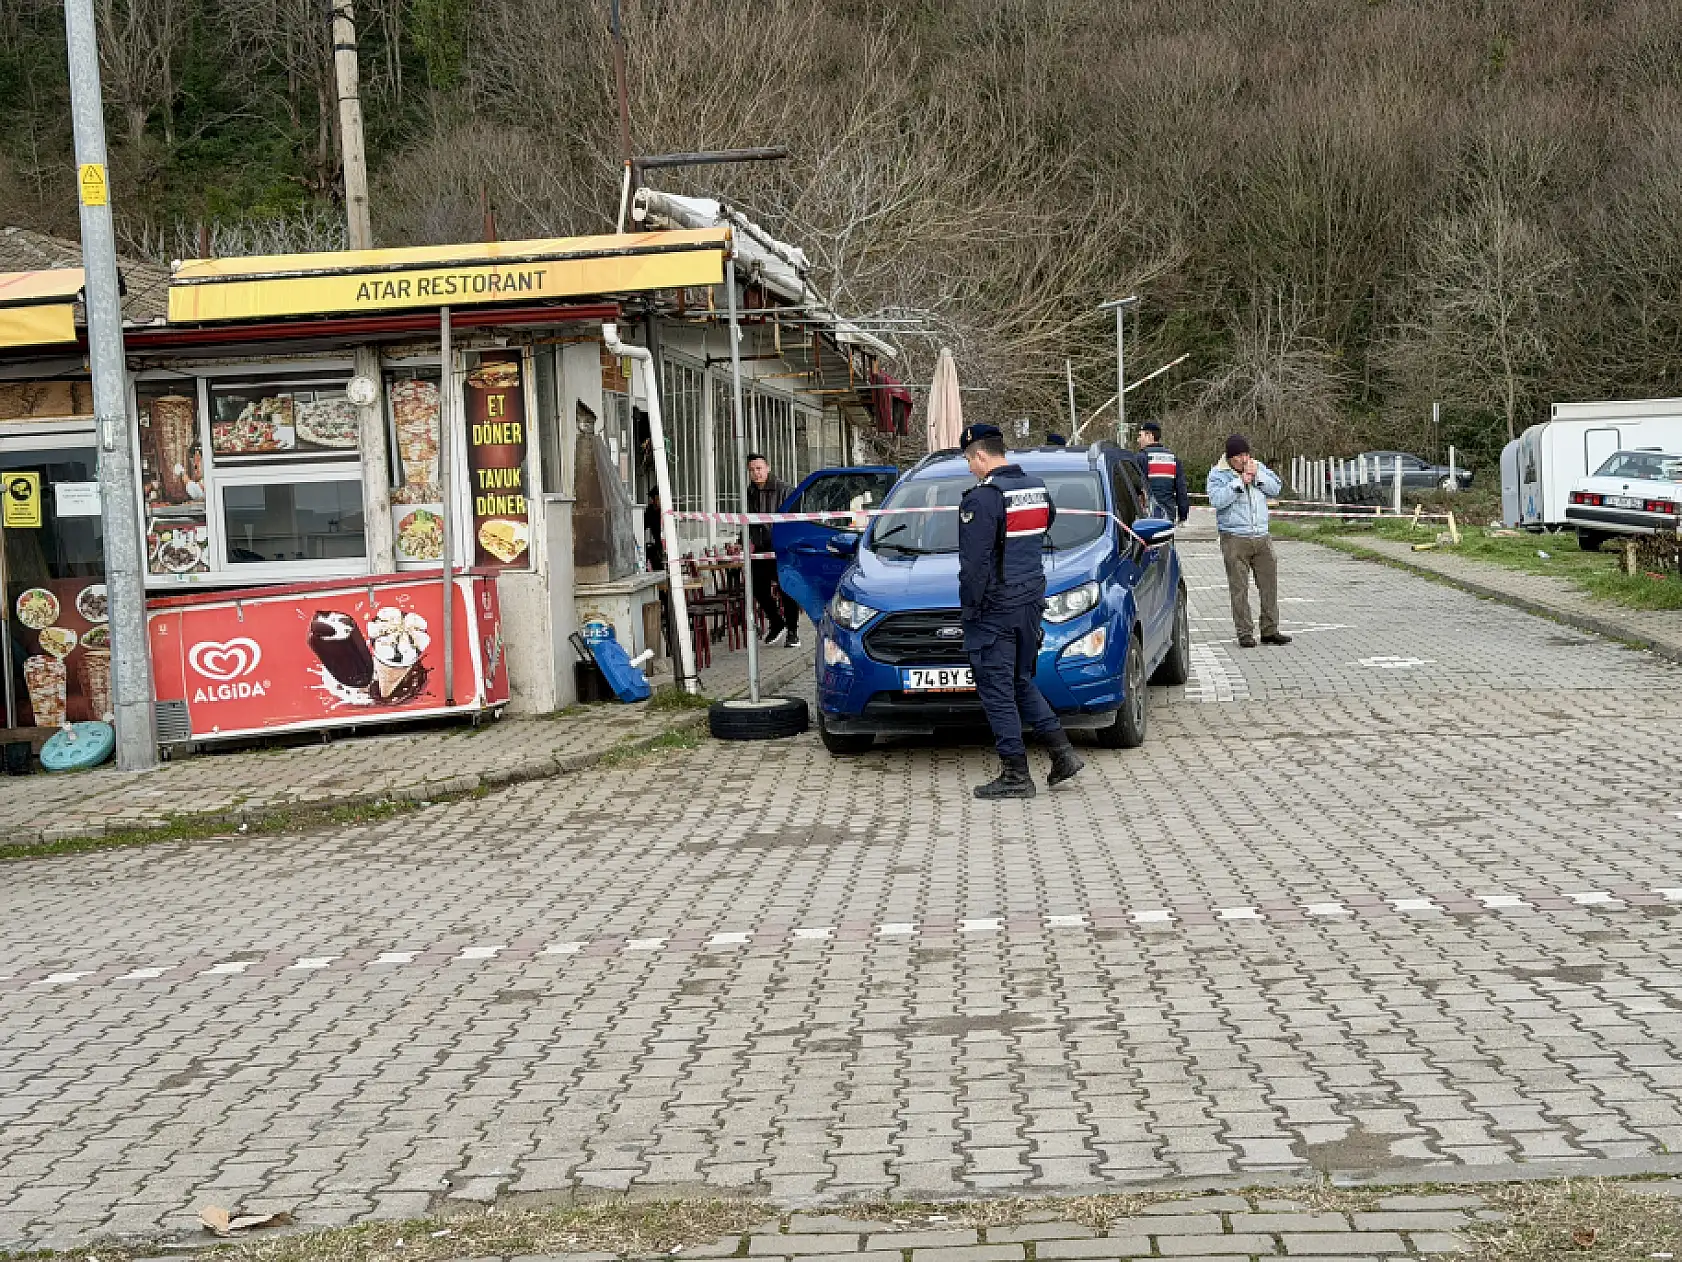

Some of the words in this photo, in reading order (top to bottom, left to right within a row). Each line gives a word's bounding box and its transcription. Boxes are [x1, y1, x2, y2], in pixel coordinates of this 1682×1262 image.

[356, 279, 411, 302] ATAR
[417, 270, 547, 297] RESTORANT
[487, 395, 505, 416] ET
[473, 420, 522, 446] DÖNER
[477, 467, 521, 489] TAVUK
[476, 492, 526, 516] DÖNER
[912, 671, 936, 687] 74
[939, 669, 959, 686] BY
